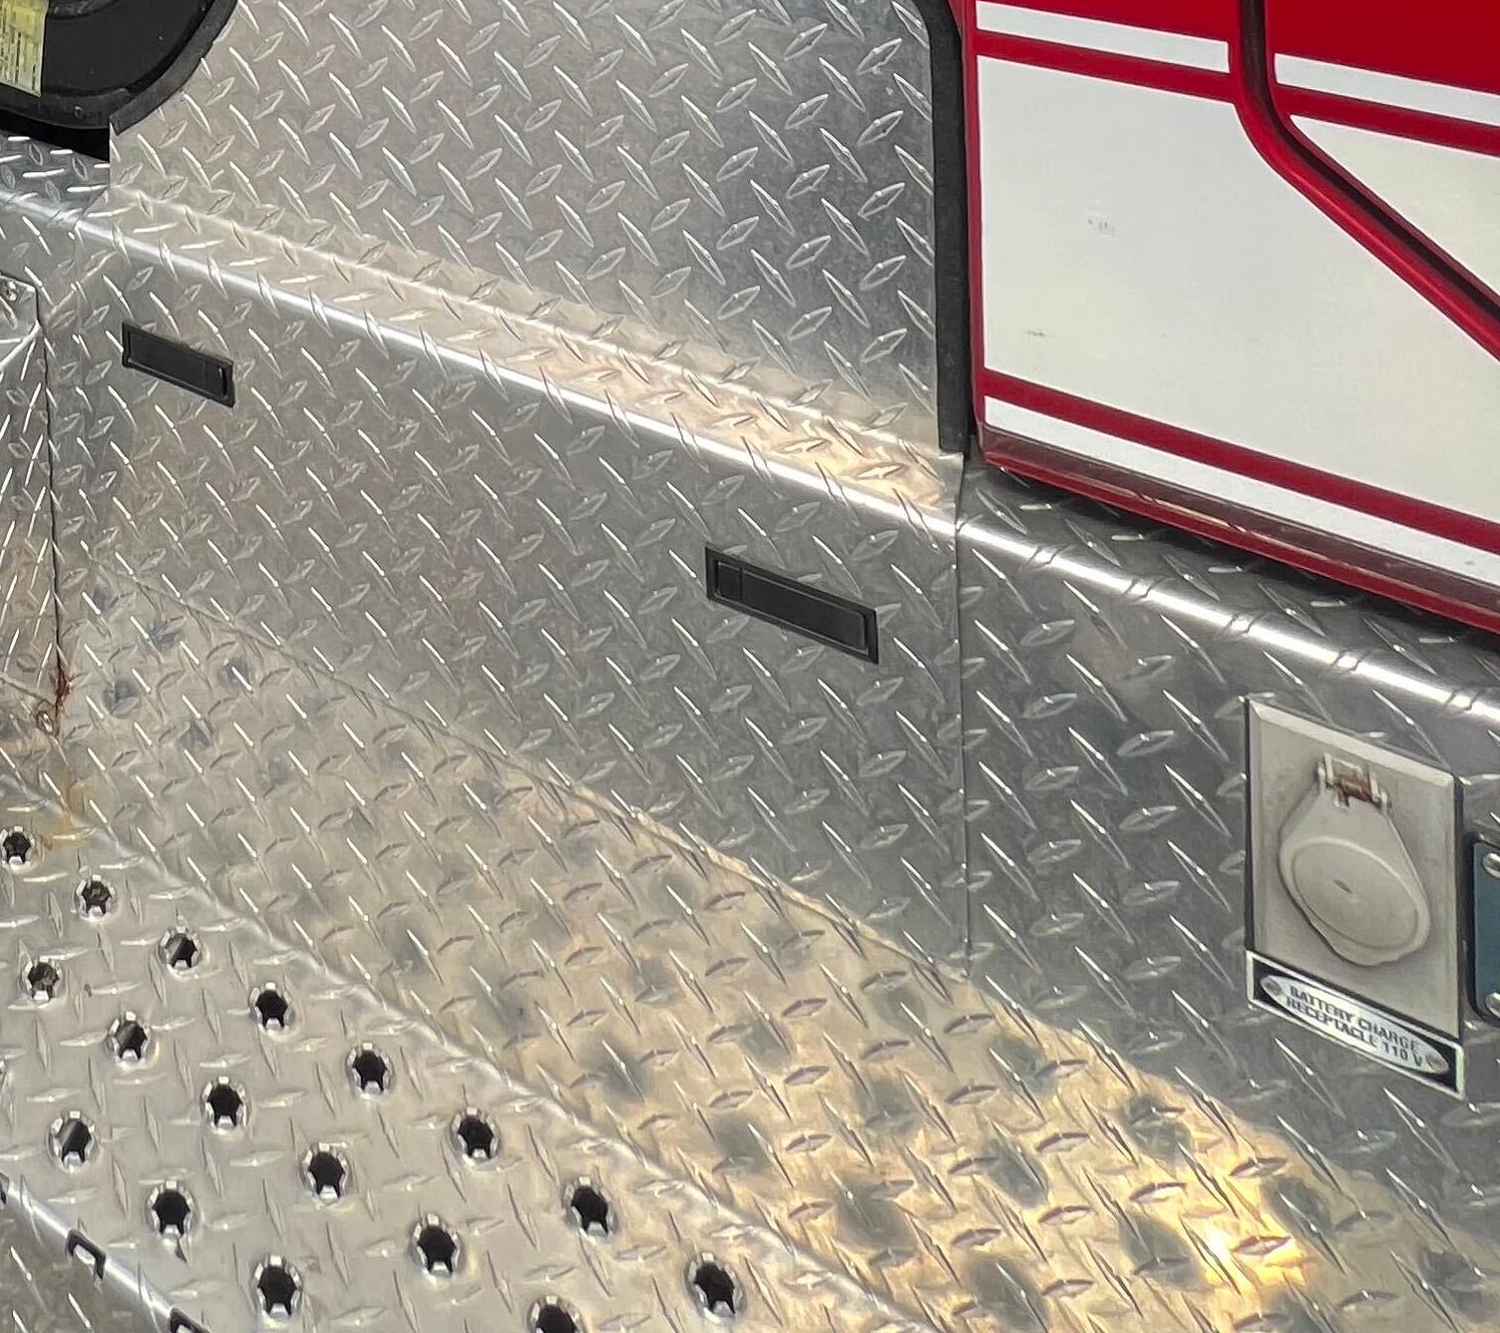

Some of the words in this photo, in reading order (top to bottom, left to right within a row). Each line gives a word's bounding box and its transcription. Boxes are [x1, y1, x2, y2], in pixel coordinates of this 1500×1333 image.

[1286, 997, 1380, 1049] RECEPTACLE
[1382, 1041, 1409, 1062] 110
[1413, 1052, 1424, 1068] V
[1290, 985, 1354, 1025] BATTERY
[1357, 1018, 1421, 1055] CHARGE
